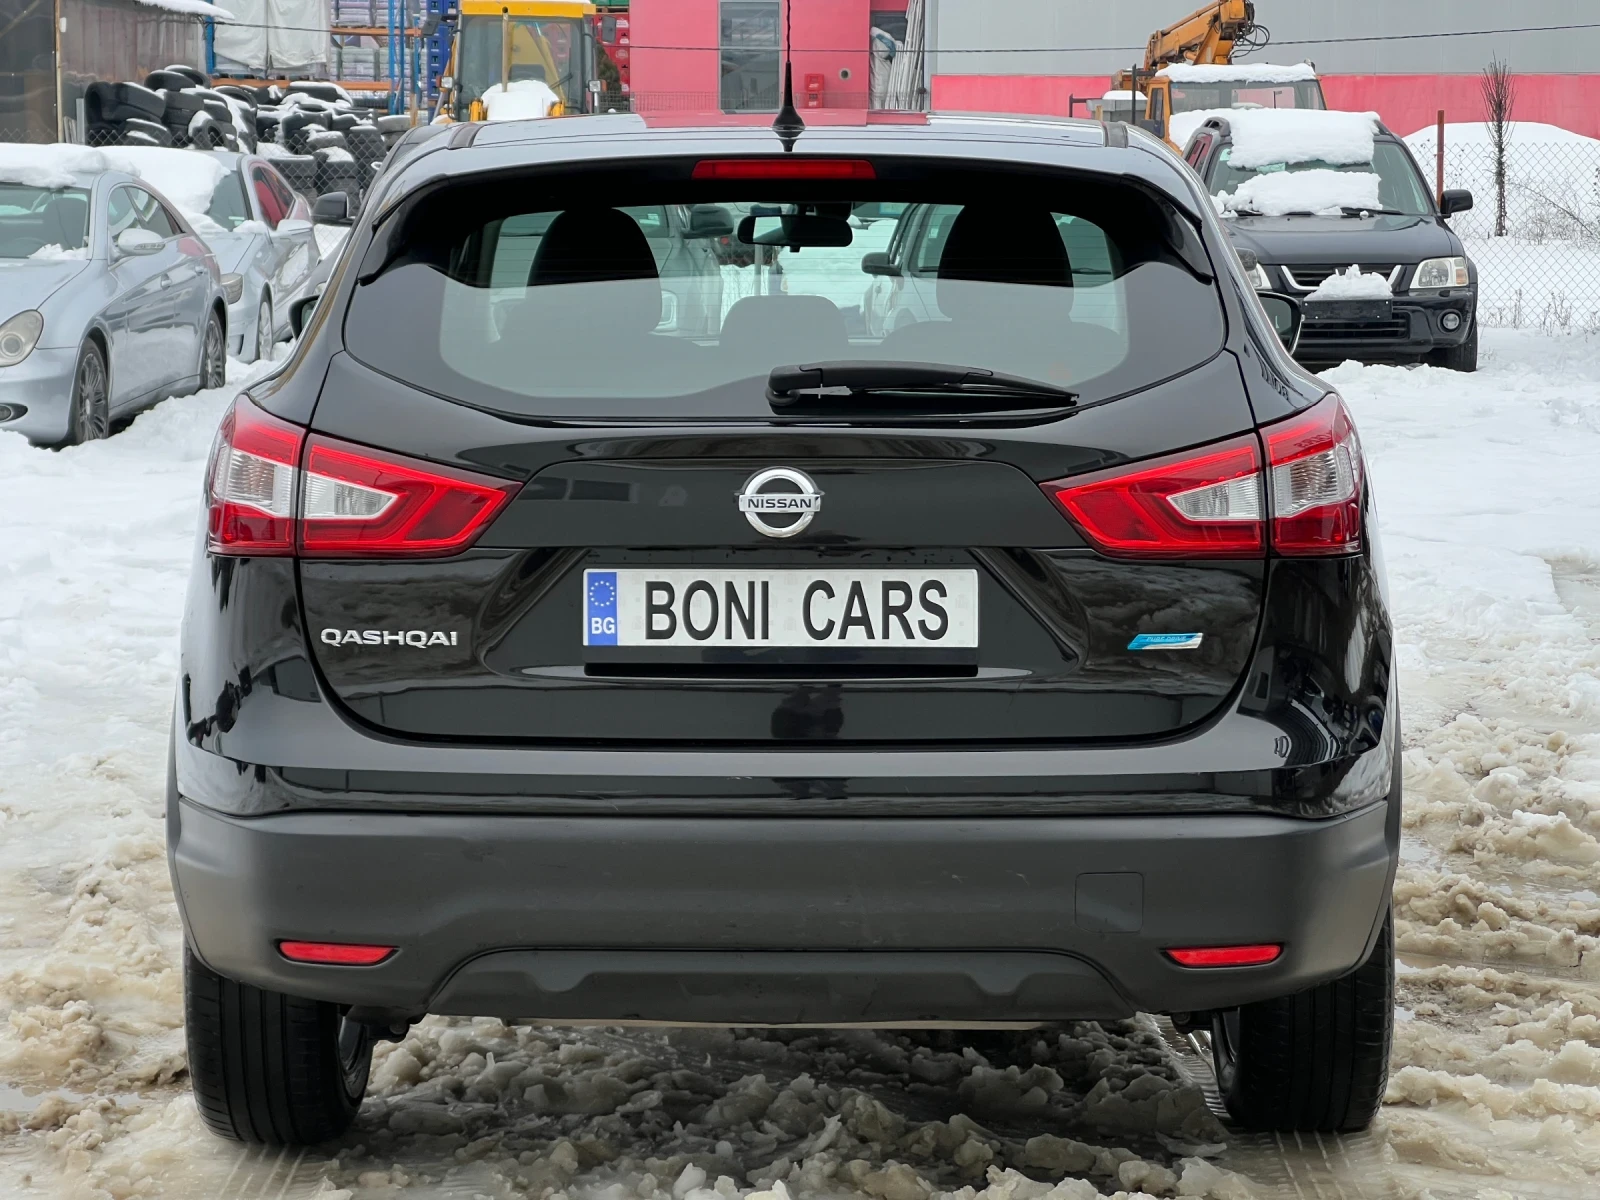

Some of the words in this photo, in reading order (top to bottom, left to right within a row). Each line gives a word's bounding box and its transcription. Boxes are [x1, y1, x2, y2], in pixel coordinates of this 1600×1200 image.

[747, 498, 812, 509] NISSAN
[645, 580, 769, 641] BONI
[802, 579, 949, 641] CARS
[591, 617, 616, 634] BG
[320, 628, 457, 648] QASHQAI
